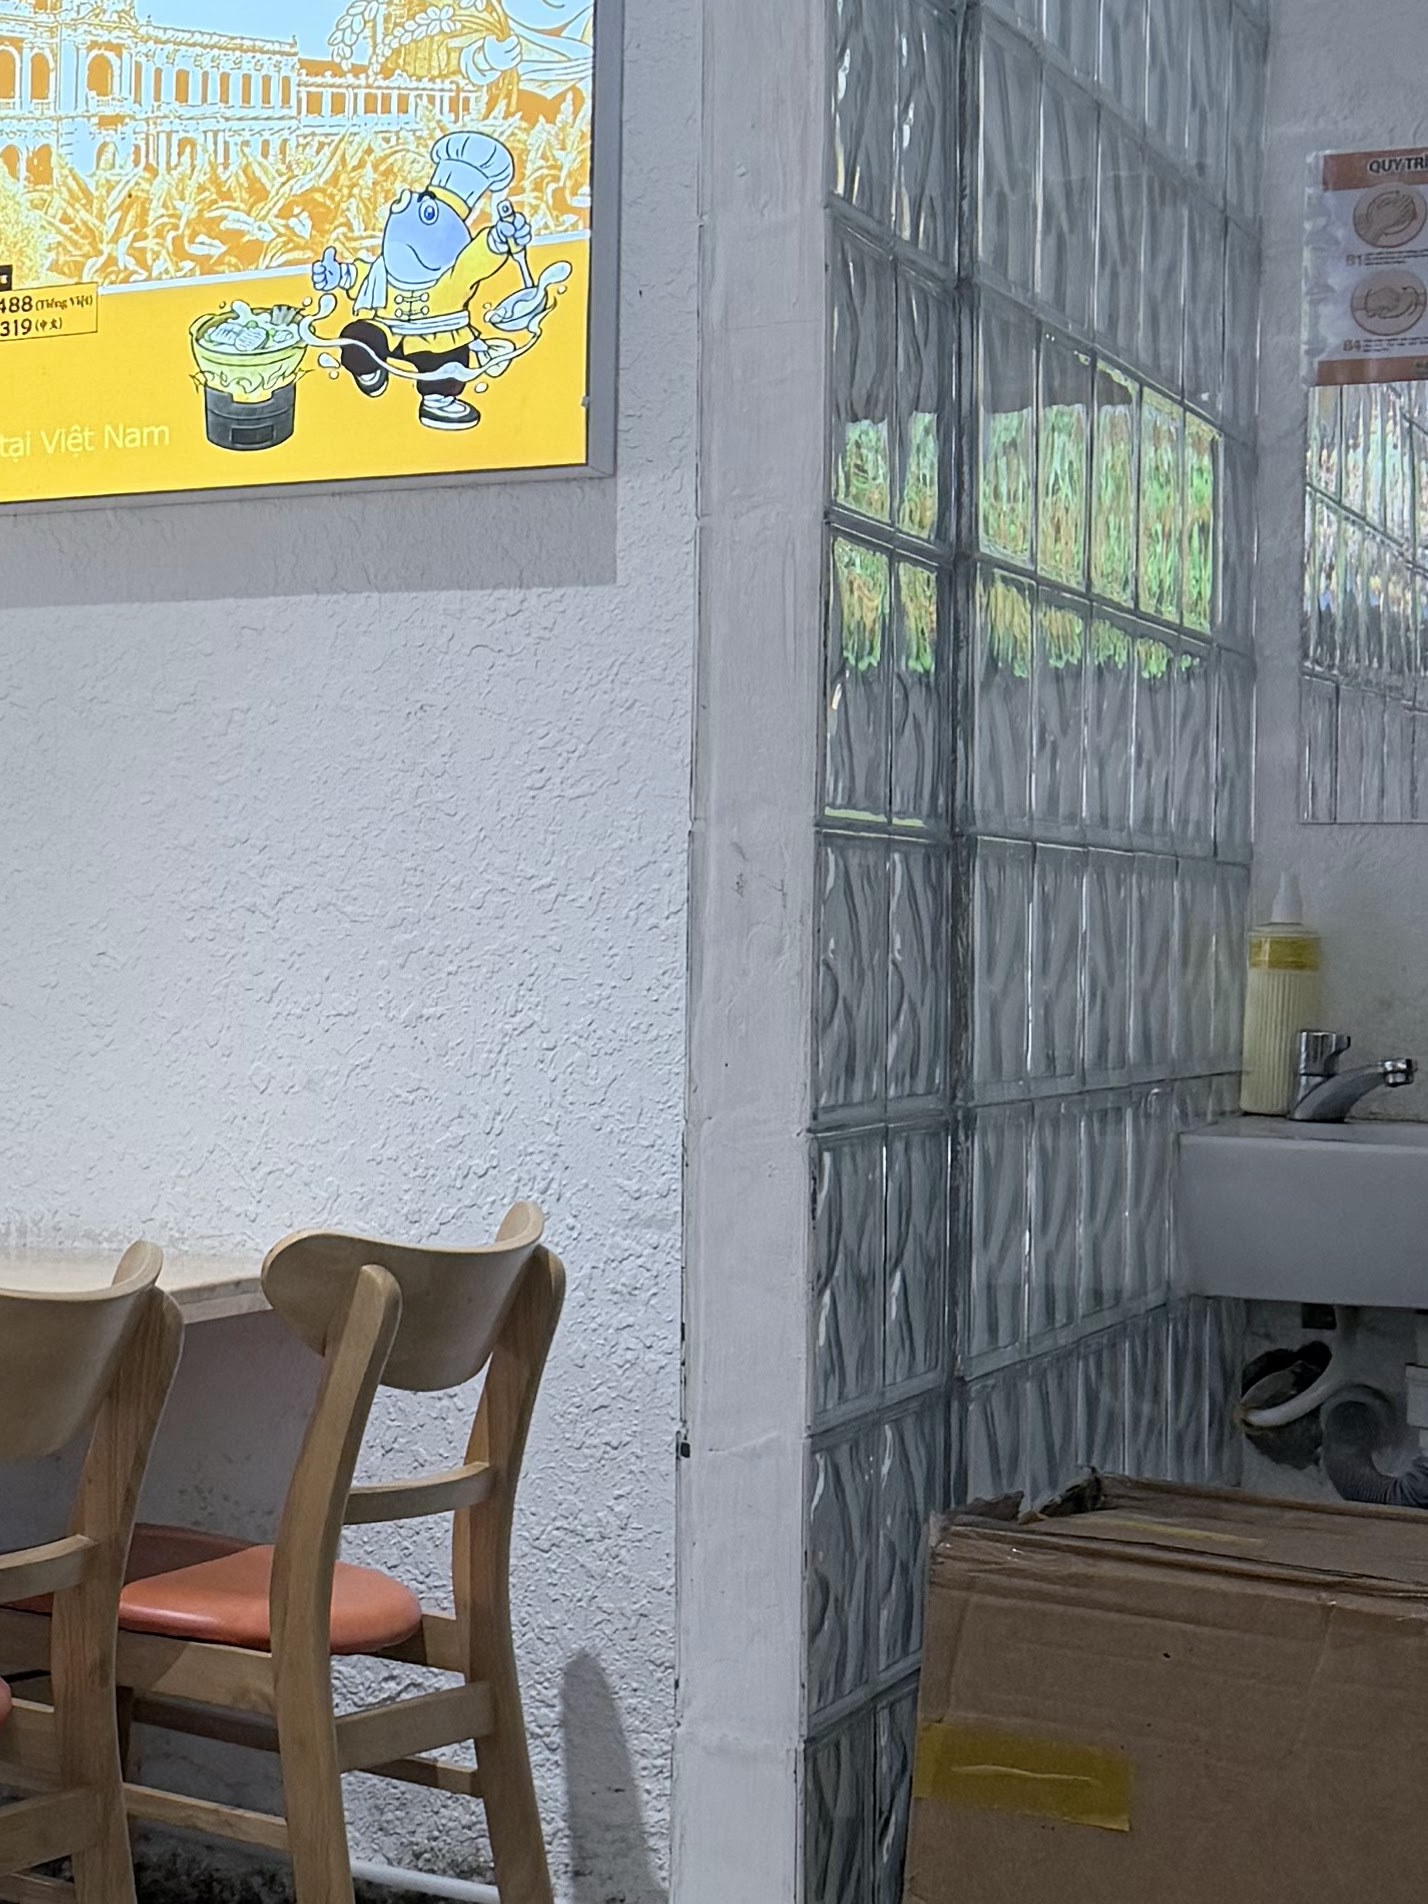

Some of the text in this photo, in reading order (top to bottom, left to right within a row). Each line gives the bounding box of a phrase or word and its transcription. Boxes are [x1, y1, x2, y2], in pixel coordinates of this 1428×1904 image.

[1369, 156, 1405, 174] QUY
[42, 425, 95, 459] Việt
[104, 424, 170, 451] Nam
